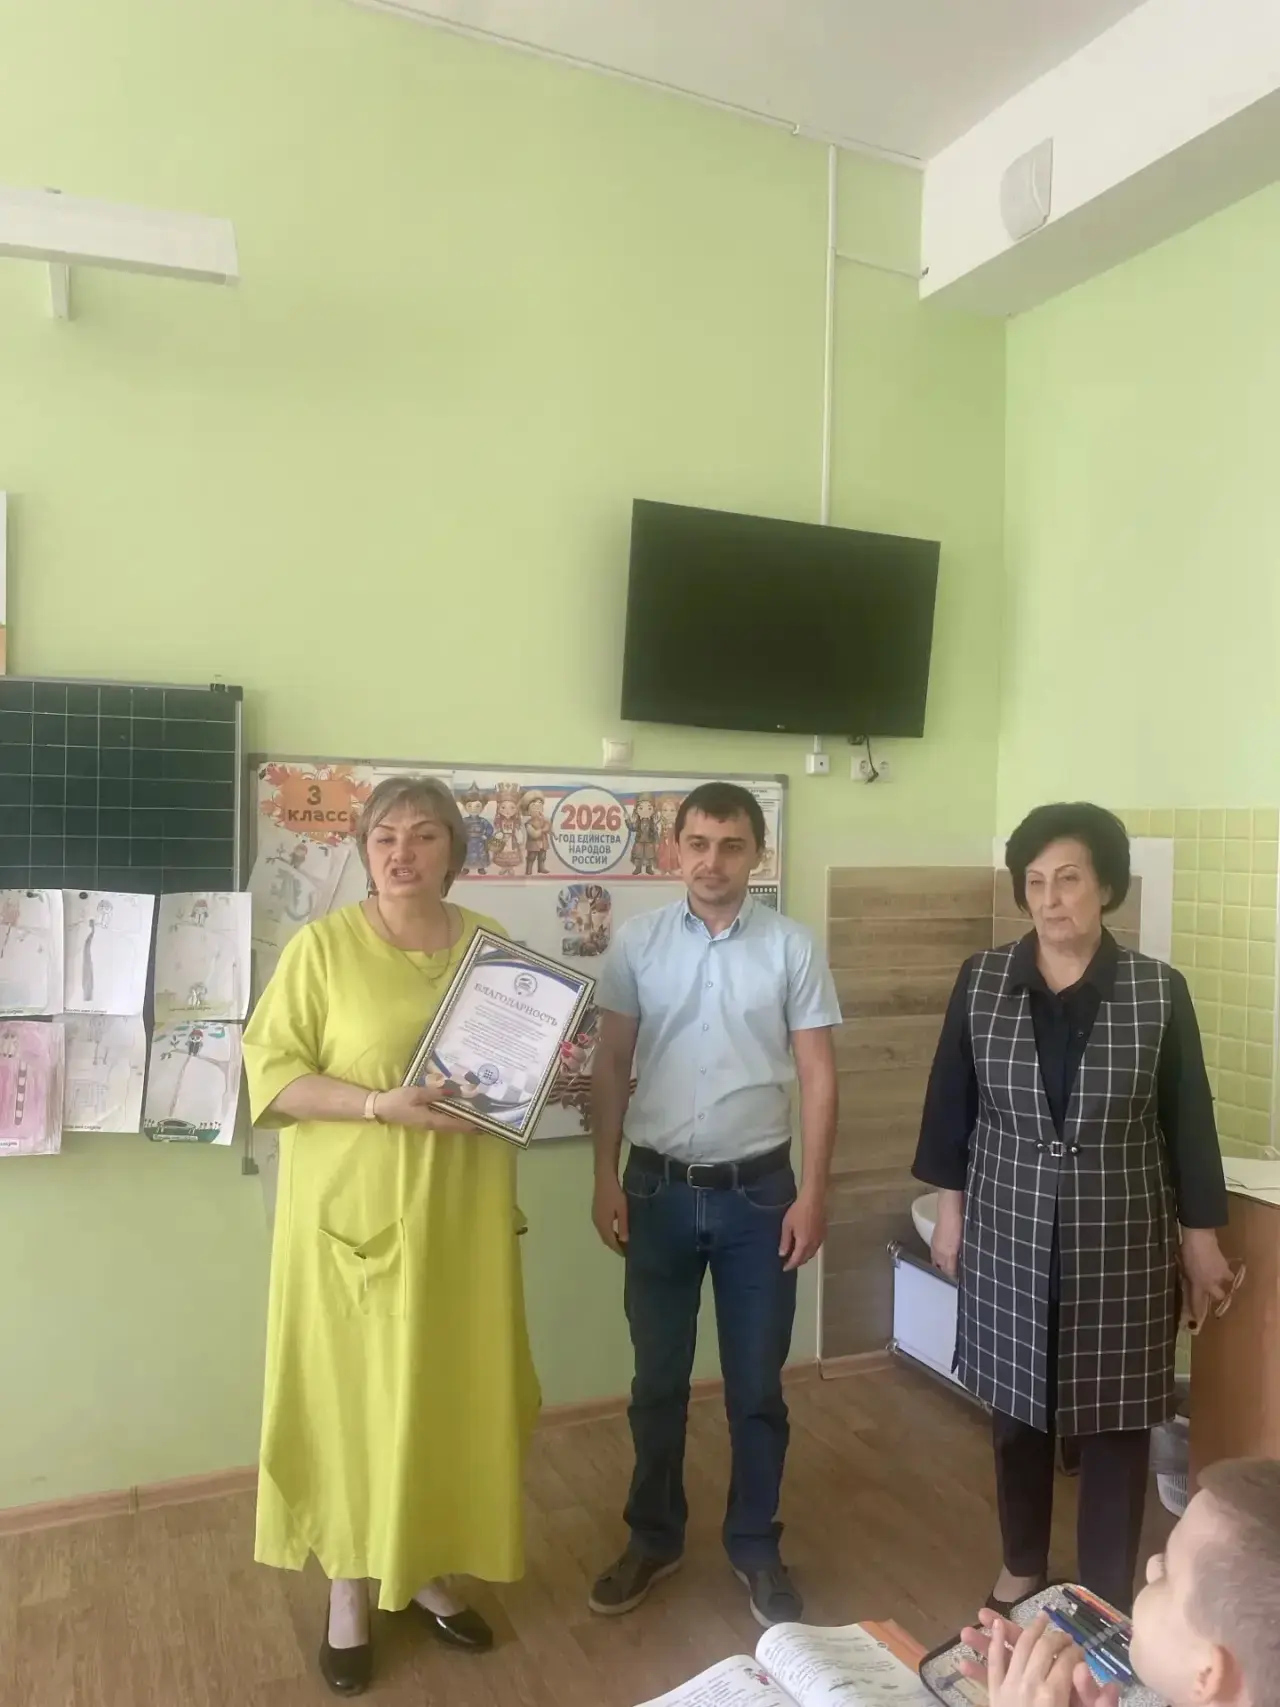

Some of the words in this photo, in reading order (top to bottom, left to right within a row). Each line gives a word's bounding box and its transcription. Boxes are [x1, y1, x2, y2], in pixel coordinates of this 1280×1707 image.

[306, 785, 322, 806] 3
[560, 803, 622, 831] 2026
[558, 833, 576, 844] ГОД
[577, 834, 622, 845] ЕДИНСТВА
[568, 844, 612, 855] НАРОДОВ
[571, 855, 608, 865] РОССИИ
[473, 982, 558, 1027] БЛАГОДАРНОСТЬ
